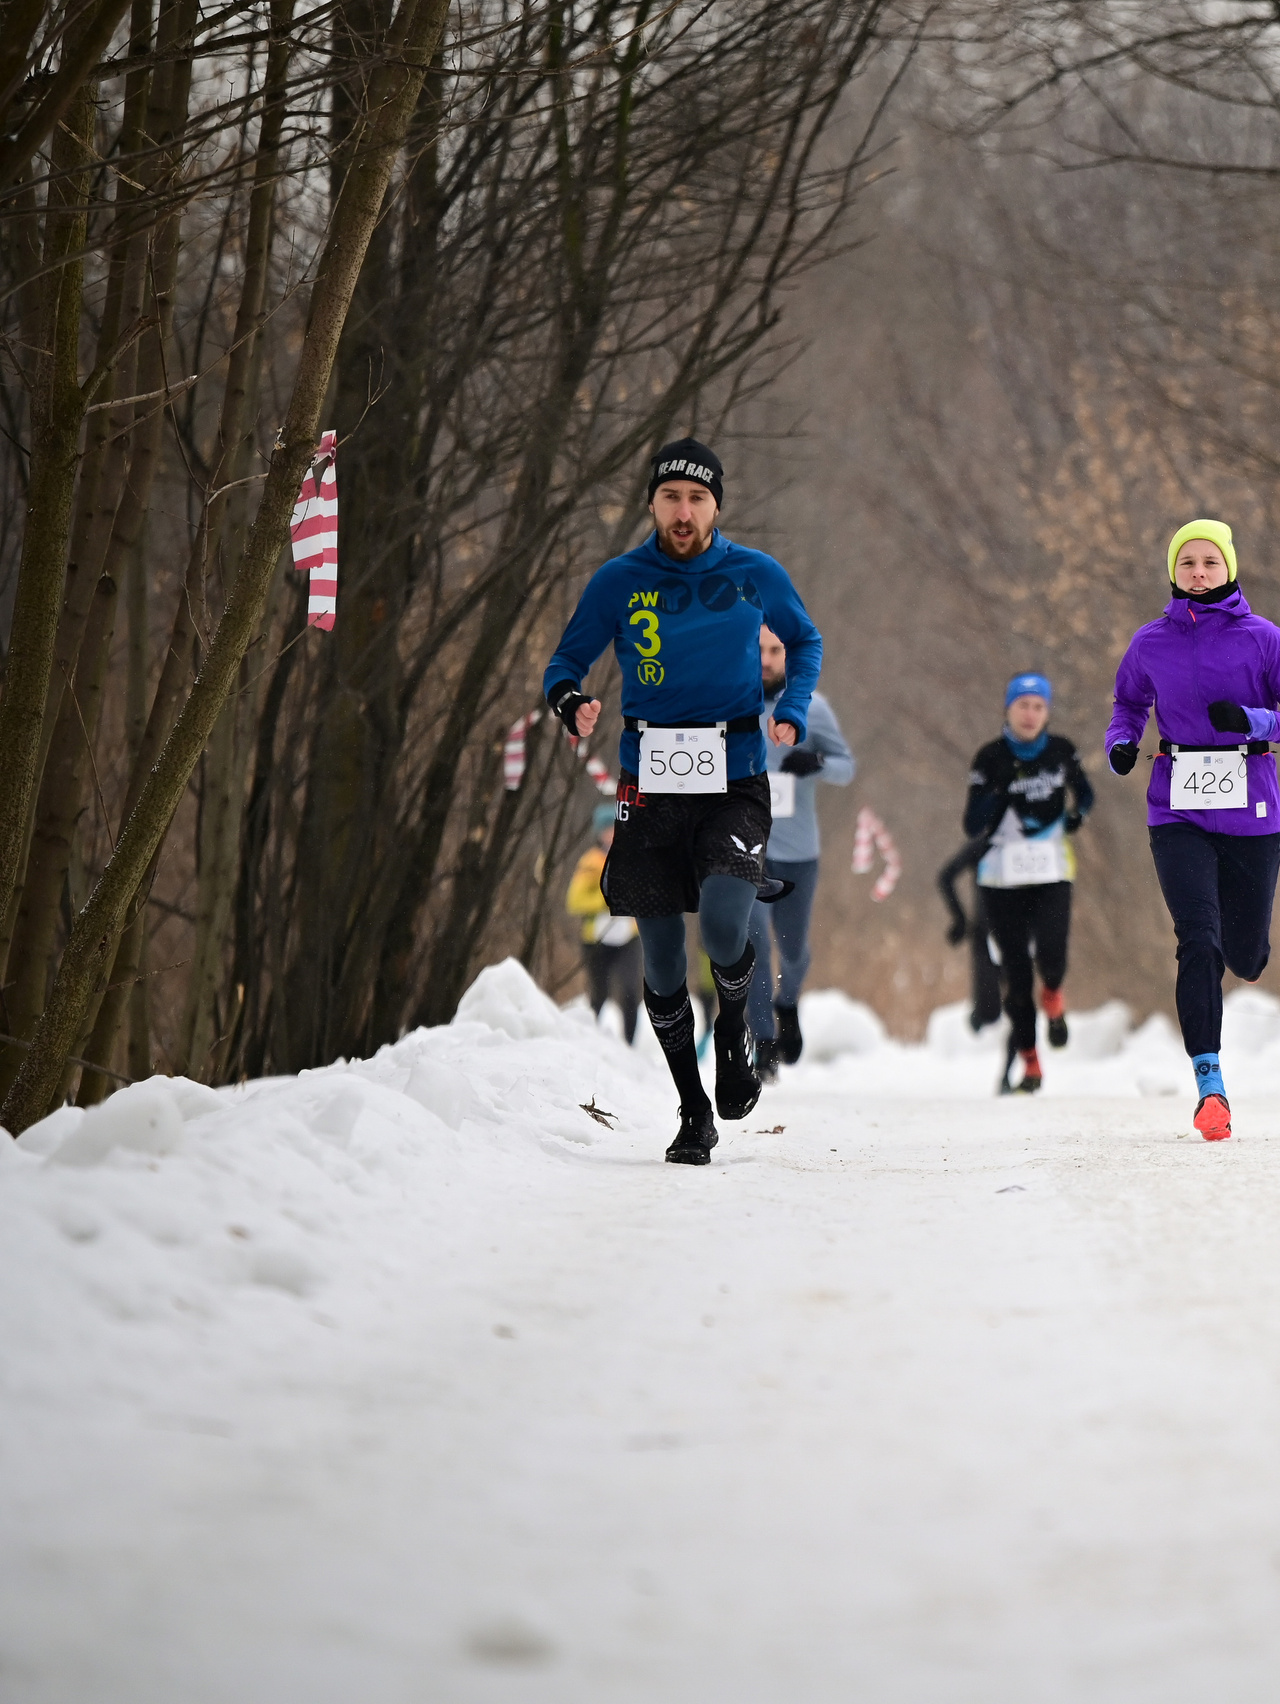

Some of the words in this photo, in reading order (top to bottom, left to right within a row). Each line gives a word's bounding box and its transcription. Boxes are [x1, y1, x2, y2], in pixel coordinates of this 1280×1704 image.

[685, 463, 714, 483] RACE
[629, 610, 661, 657] 3
[650, 750, 715, 776] 508
[1183, 771, 1234, 795] 426
